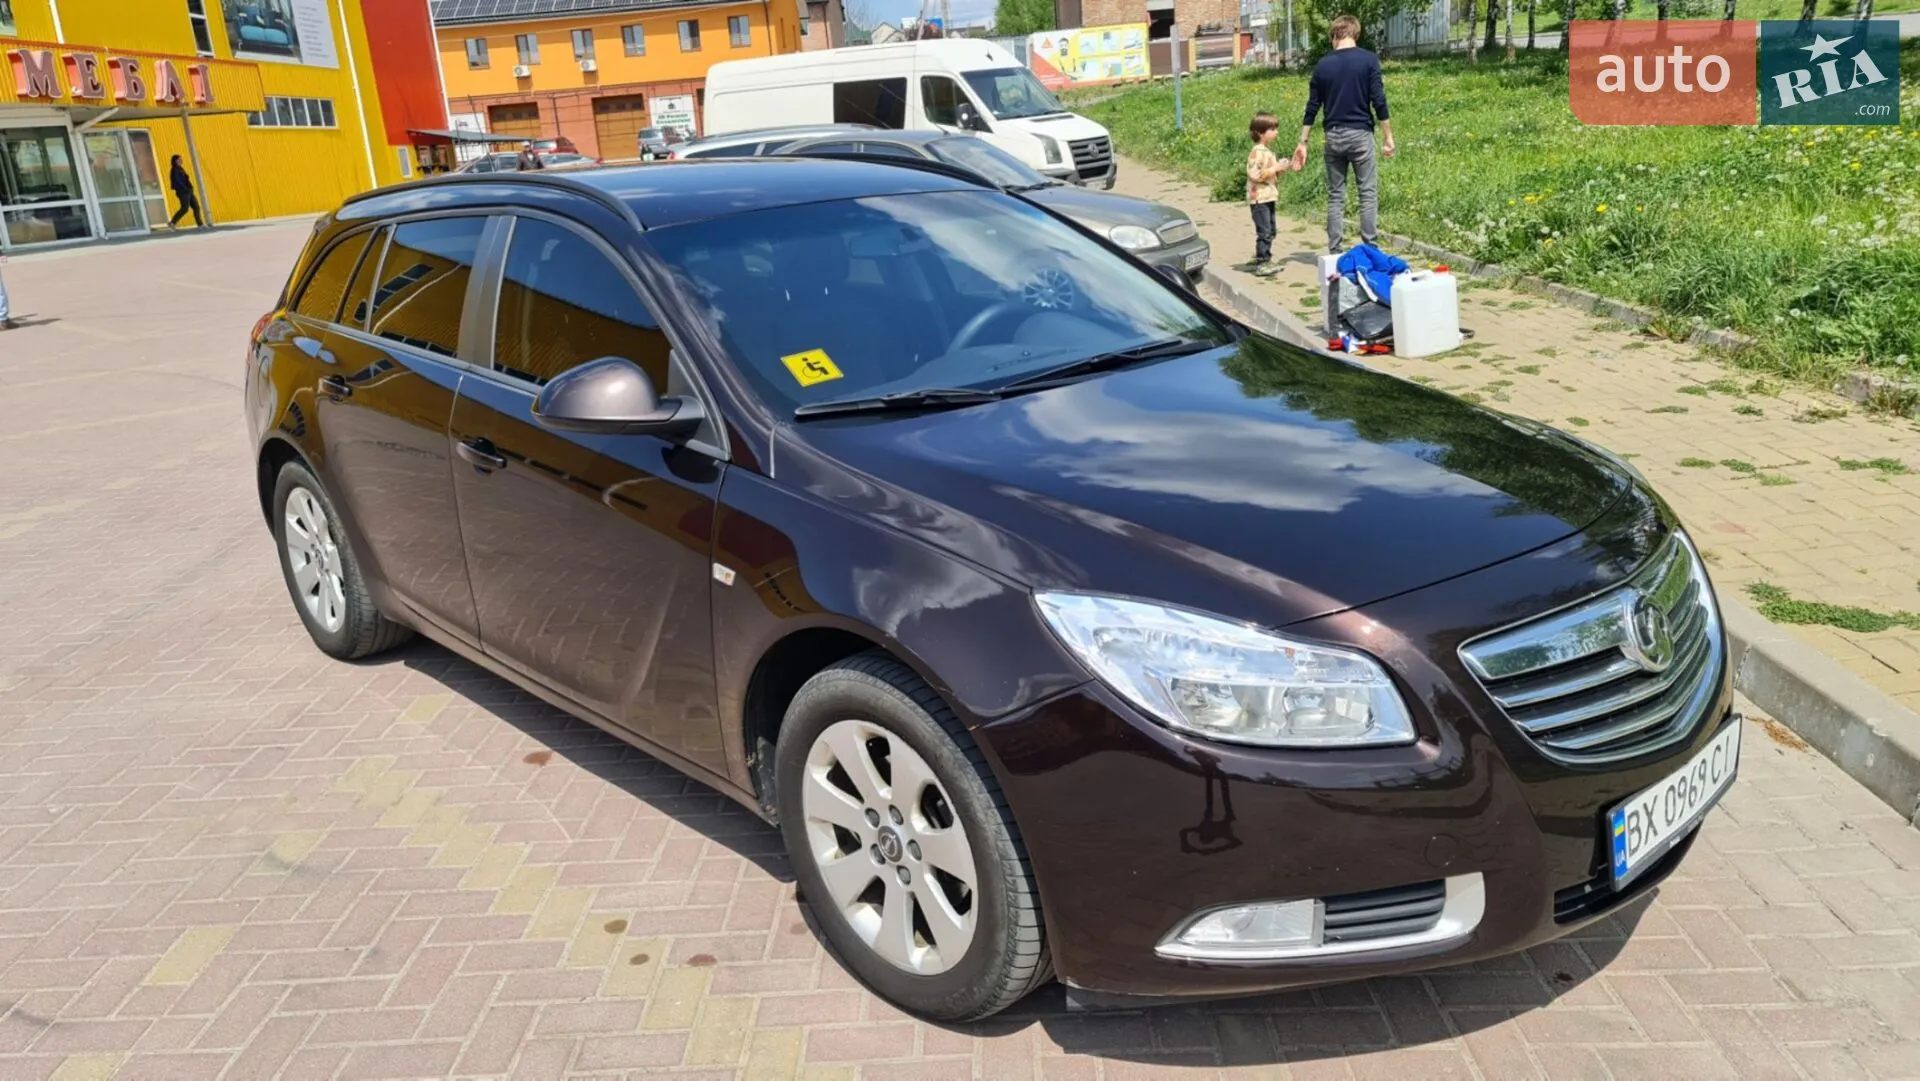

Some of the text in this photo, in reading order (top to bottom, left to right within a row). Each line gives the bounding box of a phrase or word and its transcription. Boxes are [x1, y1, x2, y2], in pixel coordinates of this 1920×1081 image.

[8, 49, 216, 104] МЕБЛІ
[1627, 795, 1658, 857] BX
[1664, 758, 1707, 827] 0969
[1615, 849, 1627, 867] UA
